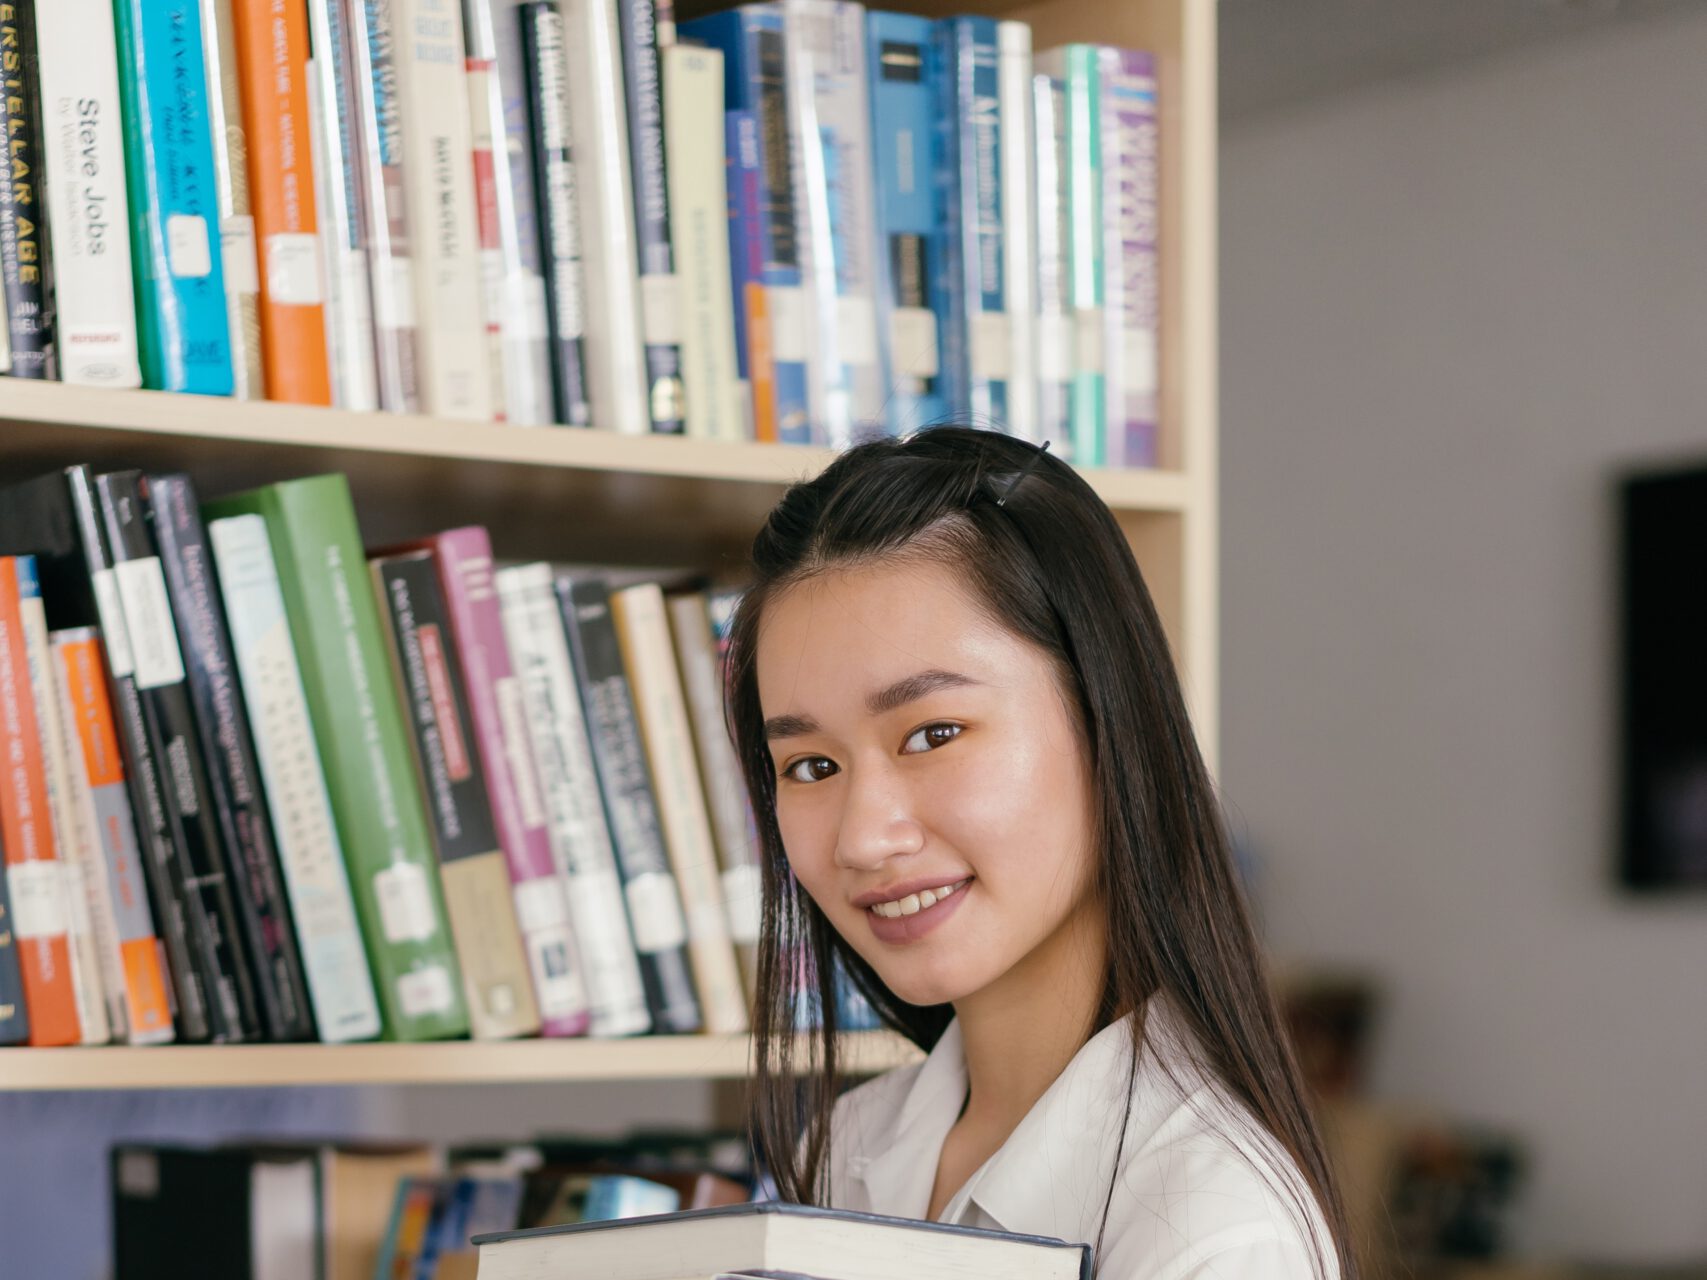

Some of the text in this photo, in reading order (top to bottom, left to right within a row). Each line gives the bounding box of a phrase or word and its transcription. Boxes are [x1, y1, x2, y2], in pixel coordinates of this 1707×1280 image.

[62, 129, 79, 174] Walter
[279, 113, 297, 168] NATIONAL
[78, 98, 110, 256] Steve Jobs
[4, 210, 20, 283] MISSION
[18, 219, 41, 285] AGE
[183, 545, 226, 673] International
[213, 675, 254, 803] Management
